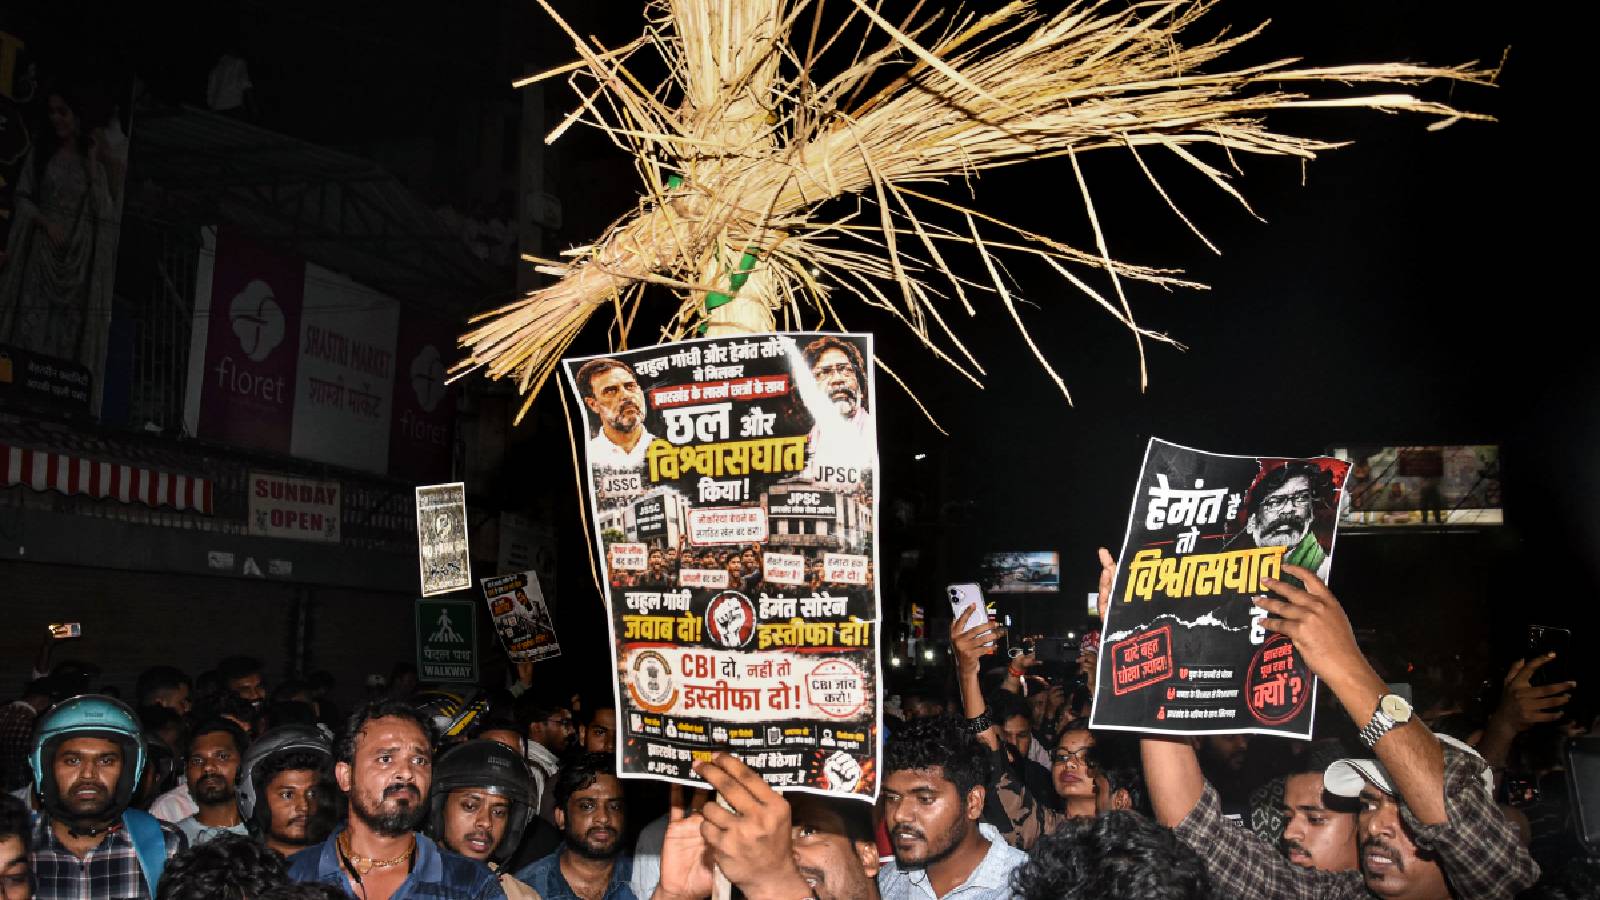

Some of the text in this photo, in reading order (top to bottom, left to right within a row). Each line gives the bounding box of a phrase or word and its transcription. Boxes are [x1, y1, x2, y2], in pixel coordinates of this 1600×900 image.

[305, 325, 392, 380] SHASTRI MARKET
[634, 357, 669, 378] राहुल
[704, 343, 728, 363] और
[729, 339, 760, 362] हेमंत
[215, 356, 286, 405] floret
[400, 408, 448, 446] floret
[662, 403, 776, 444] छल और
[648, 435, 808, 483] विश्वासघात
[605, 478, 638, 492] JSSC
[815, 466, 857, 484] JPSC
[255, 479, 337, 505] SUNDAY
[787, 492, 821, 506] JPSC
[1145, 473, 1241, 531] हेमंत है
[271, 509, 323, 531] OPEN
[1176, 527, 1201, 554] तो
[1124, 546, 1287, 602] विश्वासघात
[624, 589, 692, 615] राहुल गांधी
[759, 591, 848, 619] हेमंत सोरेन
[623, 613, 702, 642] जवाब दो!
[756, 615, 869, 649] इस्तीफा दो!
[424, 665, 472, 679] WALKWAY
[681, 653, 715, 679] CBI
[747, 660, 774, 678] नहीं
[776, 658, 791, 676] तो
[1117, 665, 1140, 683] धोखा
[684, 680, 761, 711] इस्तीफा
[812, 680, 832, 690] CBI
